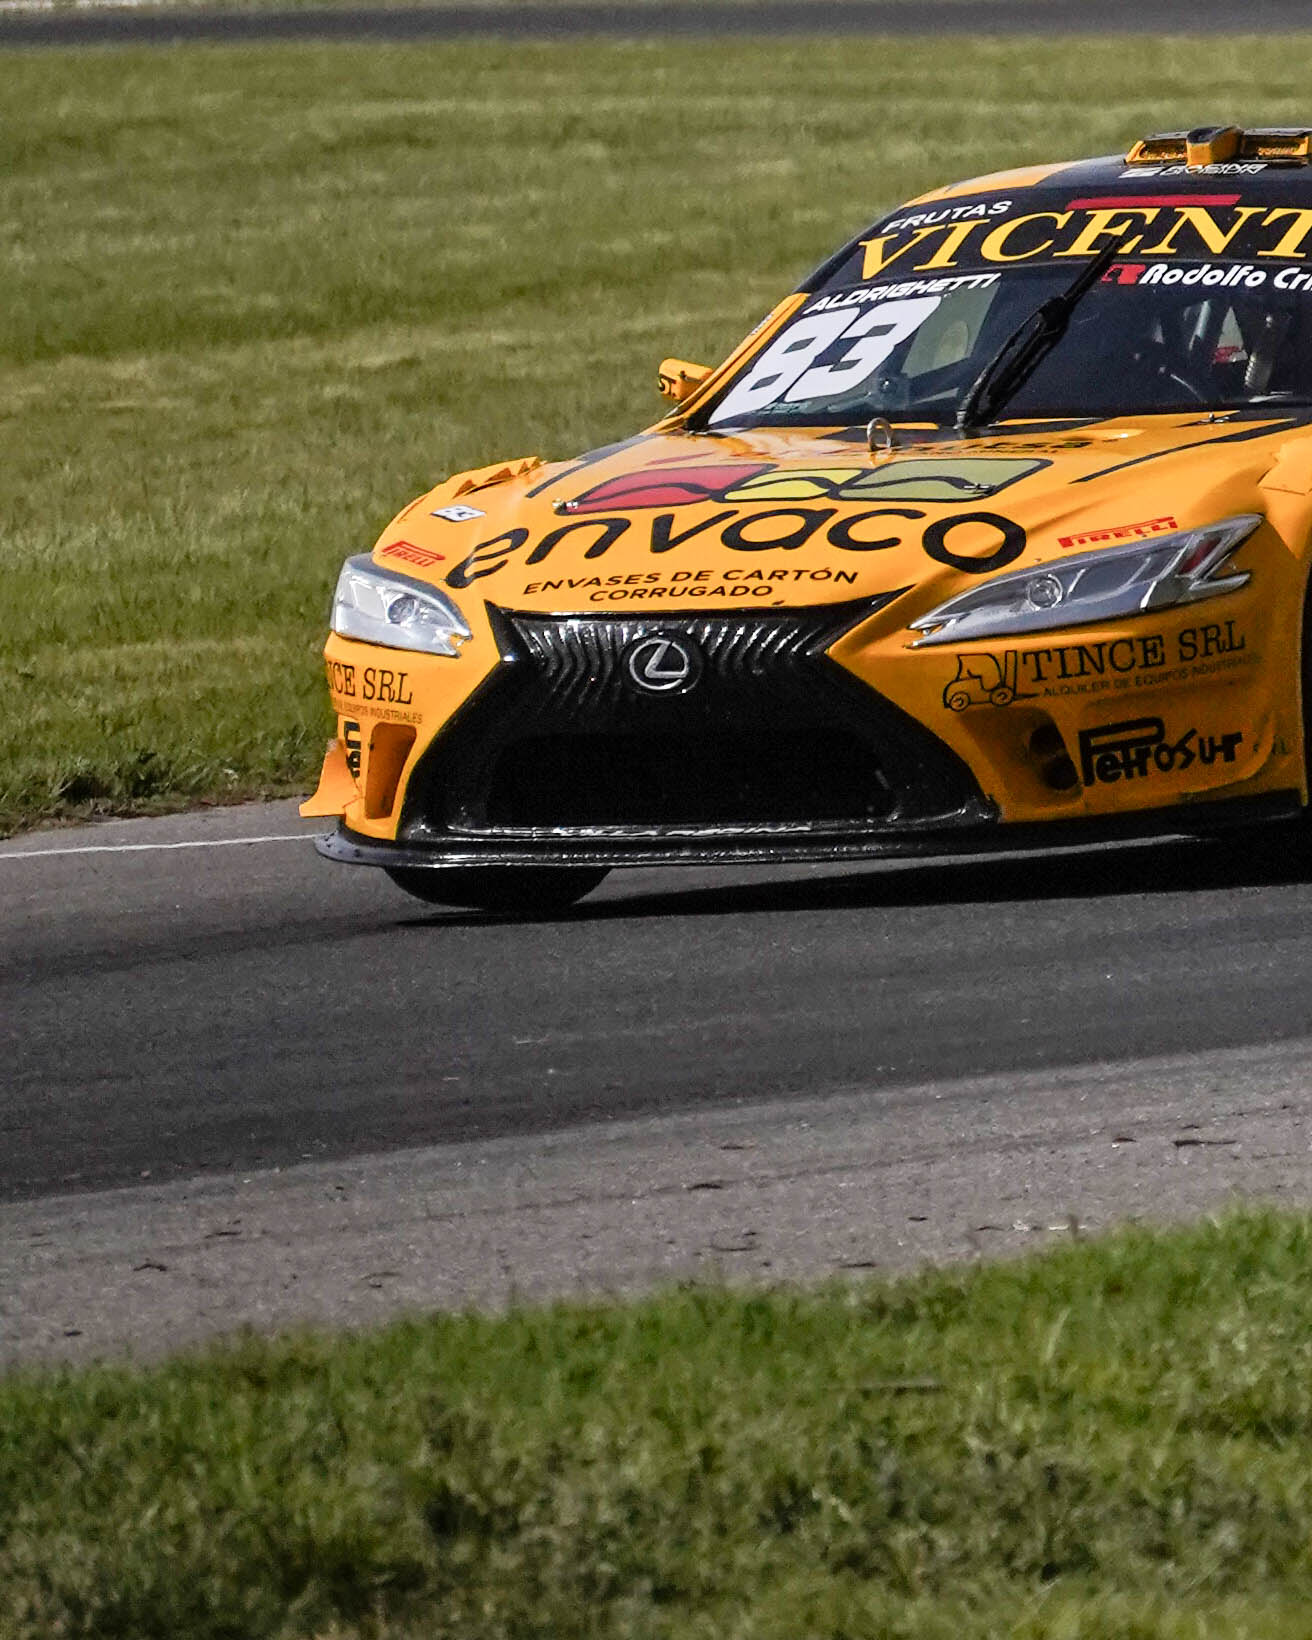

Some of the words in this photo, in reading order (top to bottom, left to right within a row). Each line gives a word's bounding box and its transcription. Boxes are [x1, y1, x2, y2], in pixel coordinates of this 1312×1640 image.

[881, 200, 1012, 233] FRUTAS
[802, 273, 1001, 315] ALDRIGHETTI
[1139, 263, 1268, 287] Rodolfo
[707, 296, 942, 425] 83
[445, 508, 1027, 588] envaco
[523, 570, 670, 595] ENVASES
[674, 569, 716, 583] DE
[724, 566, 858, 583] CARTÓN
[588, 585, 773, 602] CORRUGADO
[1023, 635, 1165, 682] TINCE
[1179, 620, 1245, 661] SRL
[363, 667, 412, 705] SRL
